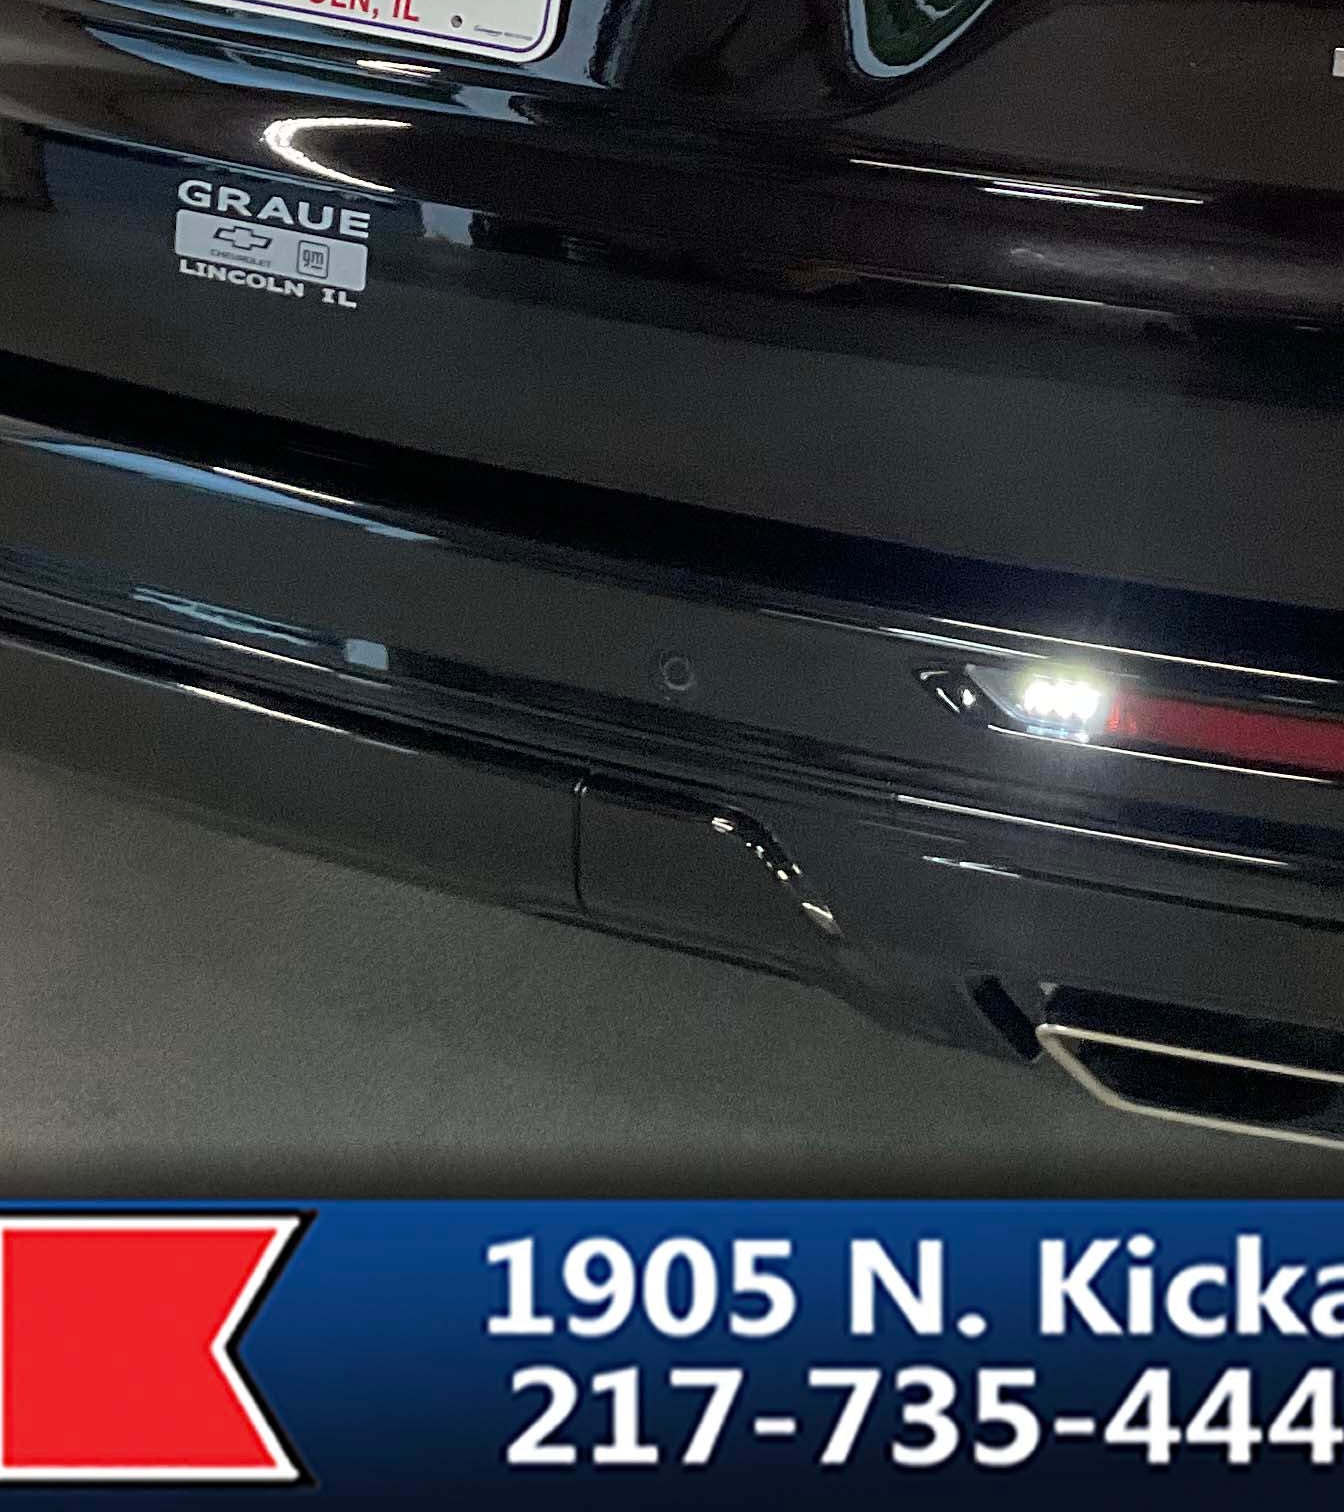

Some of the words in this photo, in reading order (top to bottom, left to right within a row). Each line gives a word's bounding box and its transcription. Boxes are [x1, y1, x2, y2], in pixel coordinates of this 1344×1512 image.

[177, 179, 371, 239] GRAUE
[179, 258, 305, 299] LINCOLN
[321, 288, 358, 309] IL
